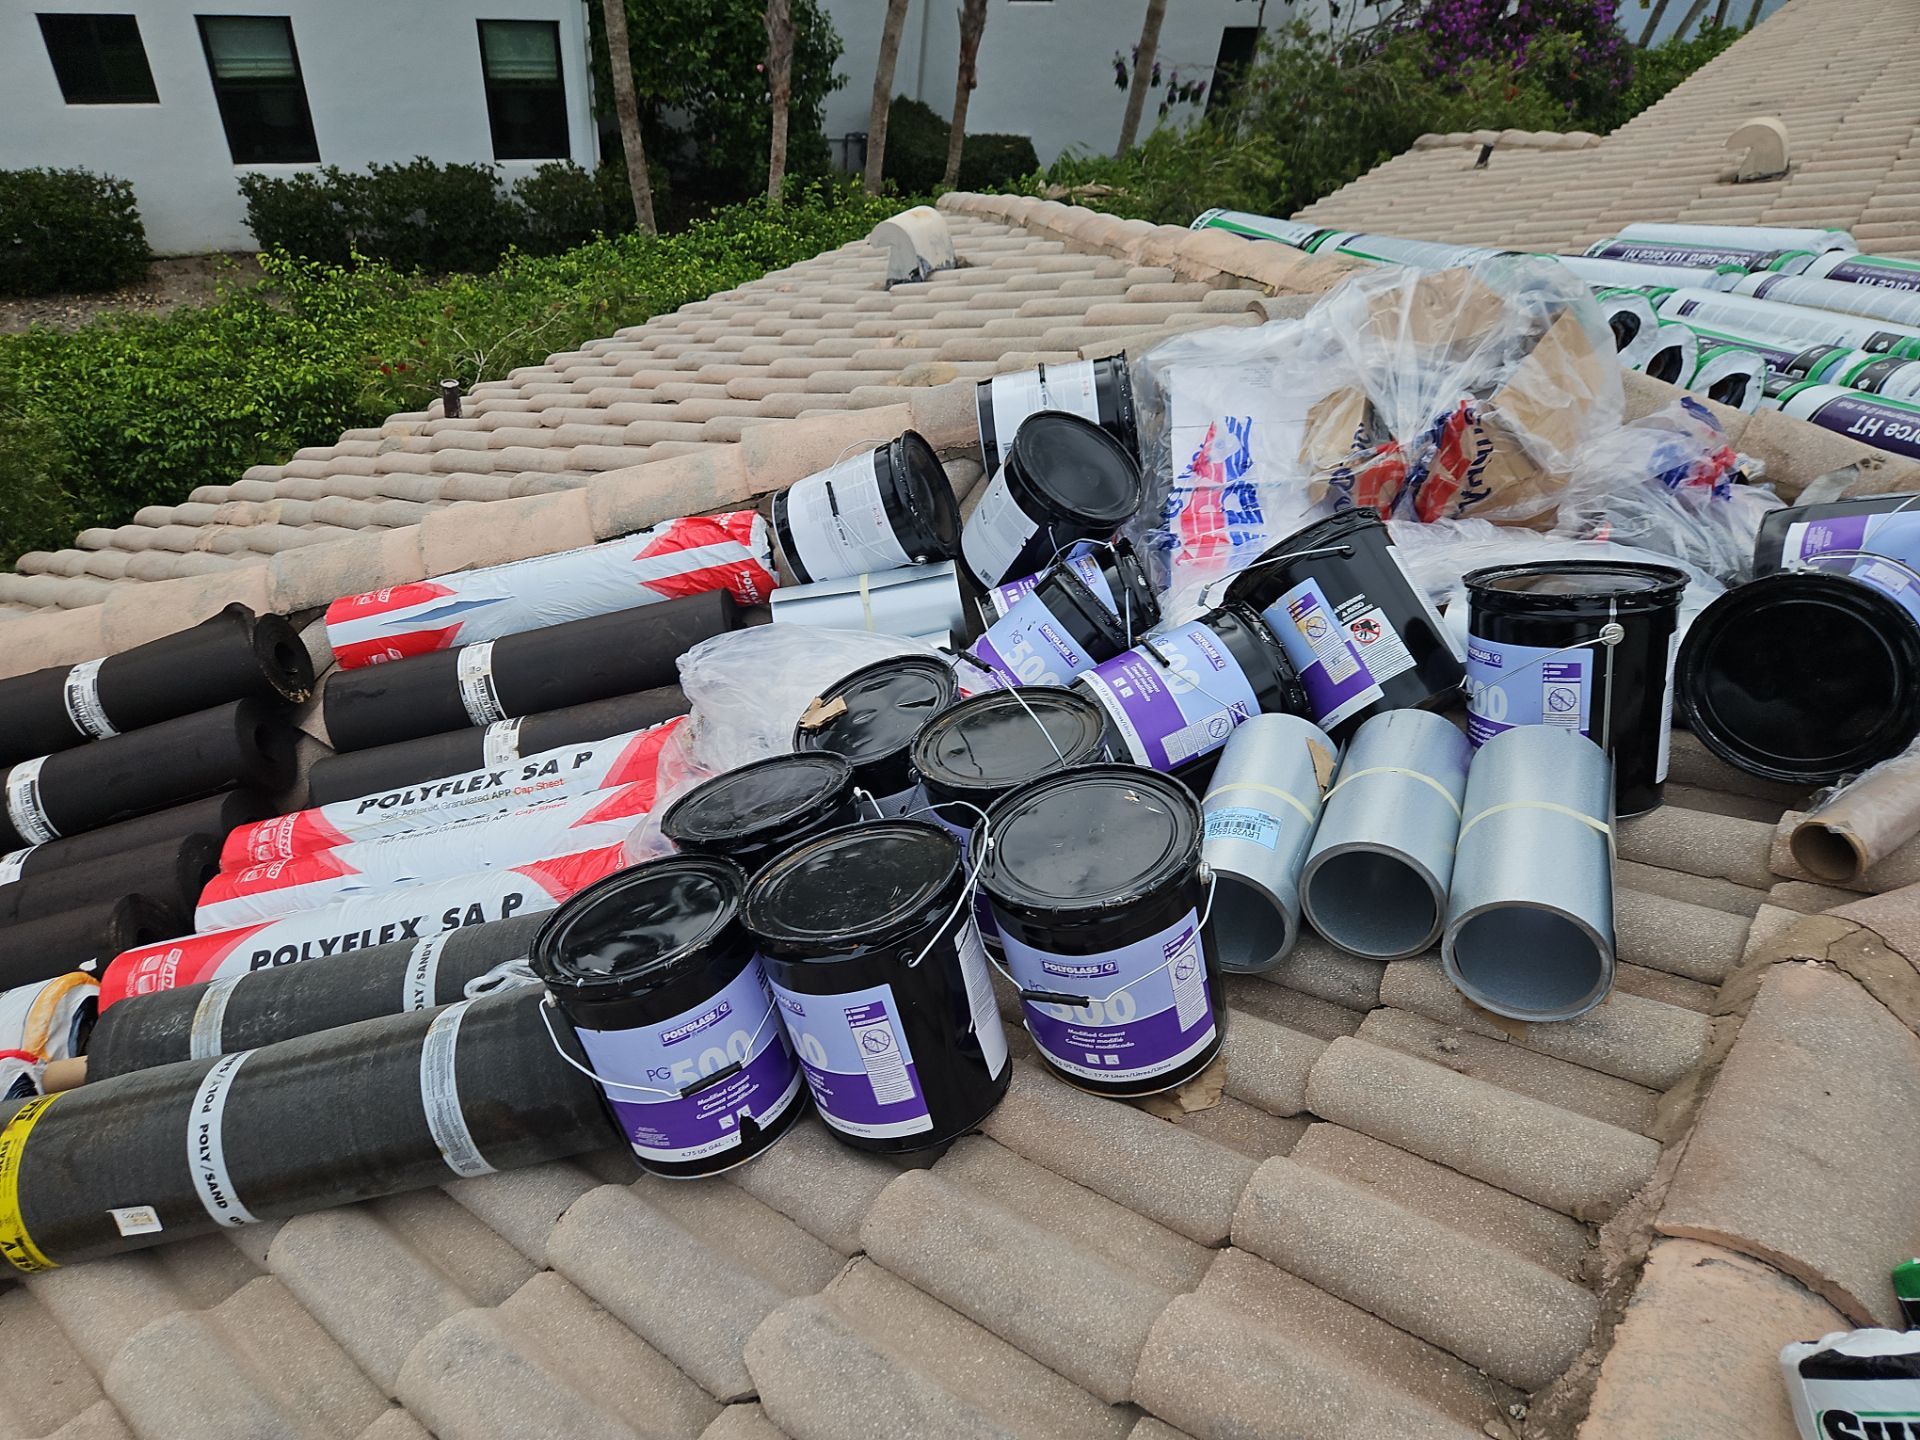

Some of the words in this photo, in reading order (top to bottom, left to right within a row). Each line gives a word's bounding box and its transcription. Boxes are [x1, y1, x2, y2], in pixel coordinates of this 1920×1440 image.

[1847, 414, 1884, 438] HT
[1884, 422, 1920, 445] orce
[1042, 624, 1071, 656] POLYGLASS
[356, 770, 507, 815] POLYFLEX
[520, 758, 559, 781] SA
[572, 751, 593, 769] P
[441, 793, 489, 810] Granulated
[491, 788, 512, 800] APP
[513, 785, 534, 797] Cap
[535, 778, 565, 791] Sheet
[249, 916, 424, 972] POLYFLEX
[441, 902, 486, 932] SA
[501, 892, 523, 920] P
[1043, 962, 1099, 974] POLYGLASS
[662, 1011, 717, 1042] POLYGLASS
[1067, 1028, 1098, 1038] Modified
[1098, 1030, 1126, 1038] Cement
[646, 1066, 672, 1082] PG
[670, 1029, 754, 1089] 500
[697, 1088, 727, 1106] Modified
[727, 1074, 751, 1093] Cement
[198, 1124, 229, 1210] POLY/SAND
